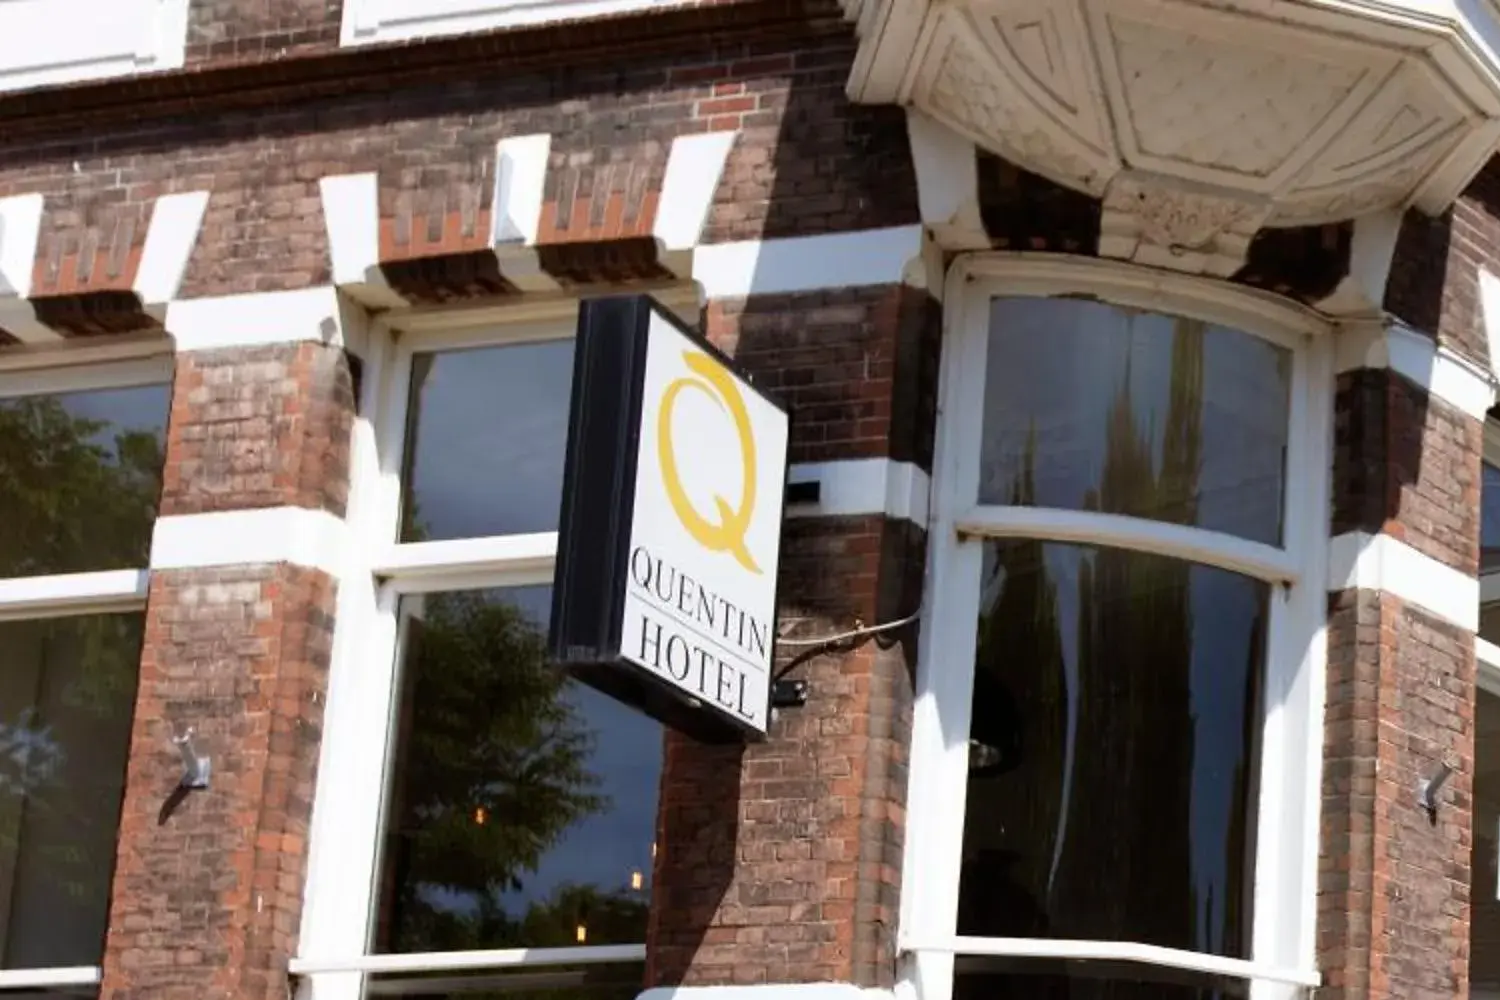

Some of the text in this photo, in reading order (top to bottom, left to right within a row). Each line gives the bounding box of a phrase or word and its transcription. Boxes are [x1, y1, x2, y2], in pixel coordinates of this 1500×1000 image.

[658, 349, 764, 575] Q
[631, 545, 768, 660] QUENTIN
[639, 616, 756, 721] HOTEL
